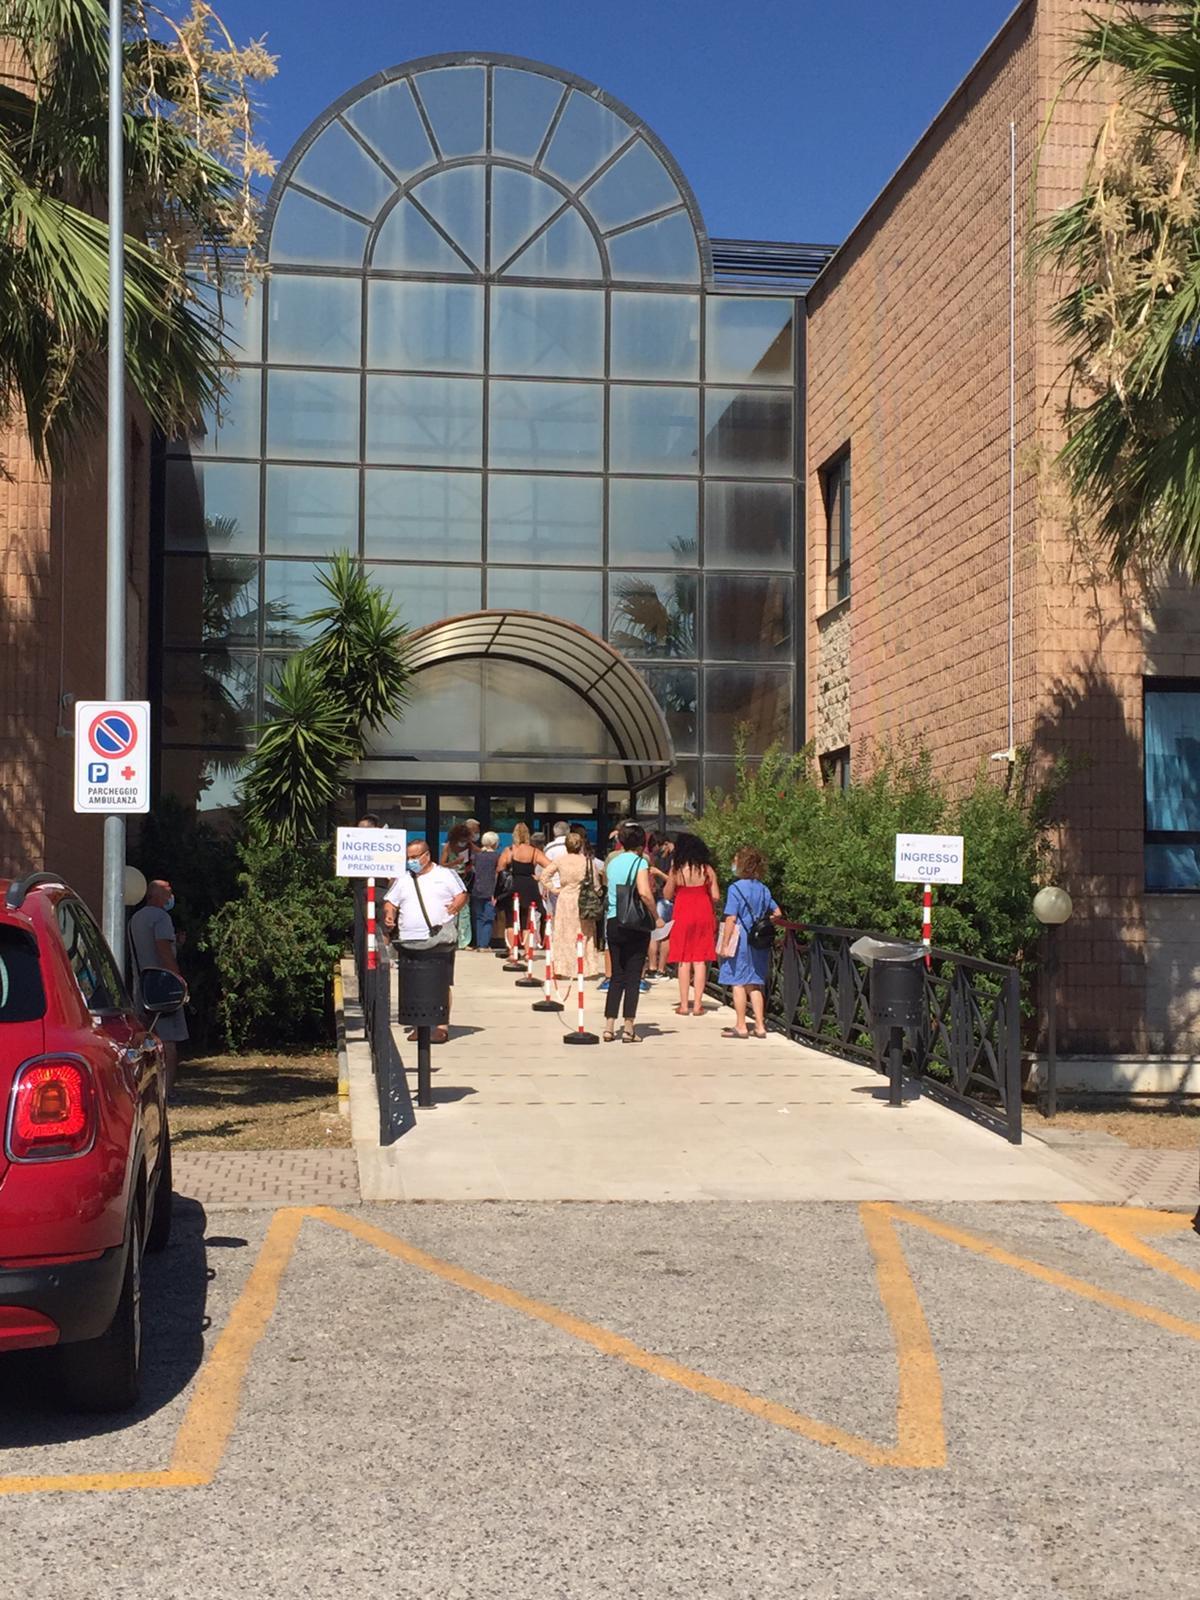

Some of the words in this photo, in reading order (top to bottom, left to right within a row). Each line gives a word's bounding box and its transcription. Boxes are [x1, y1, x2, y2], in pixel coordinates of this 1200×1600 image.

[92, 764, 107, 783] P
[88, 787, 138, 796] PARCHEGGIO
[88, 796, 137, 804] AMBULANZA
[342, 841, 402, 853] INGRESSO
[900, 852, 959, 863] INGRESSO
[347, 863, 395, 871] PRENOTATE
[917, 866, 941, 875] CUP
